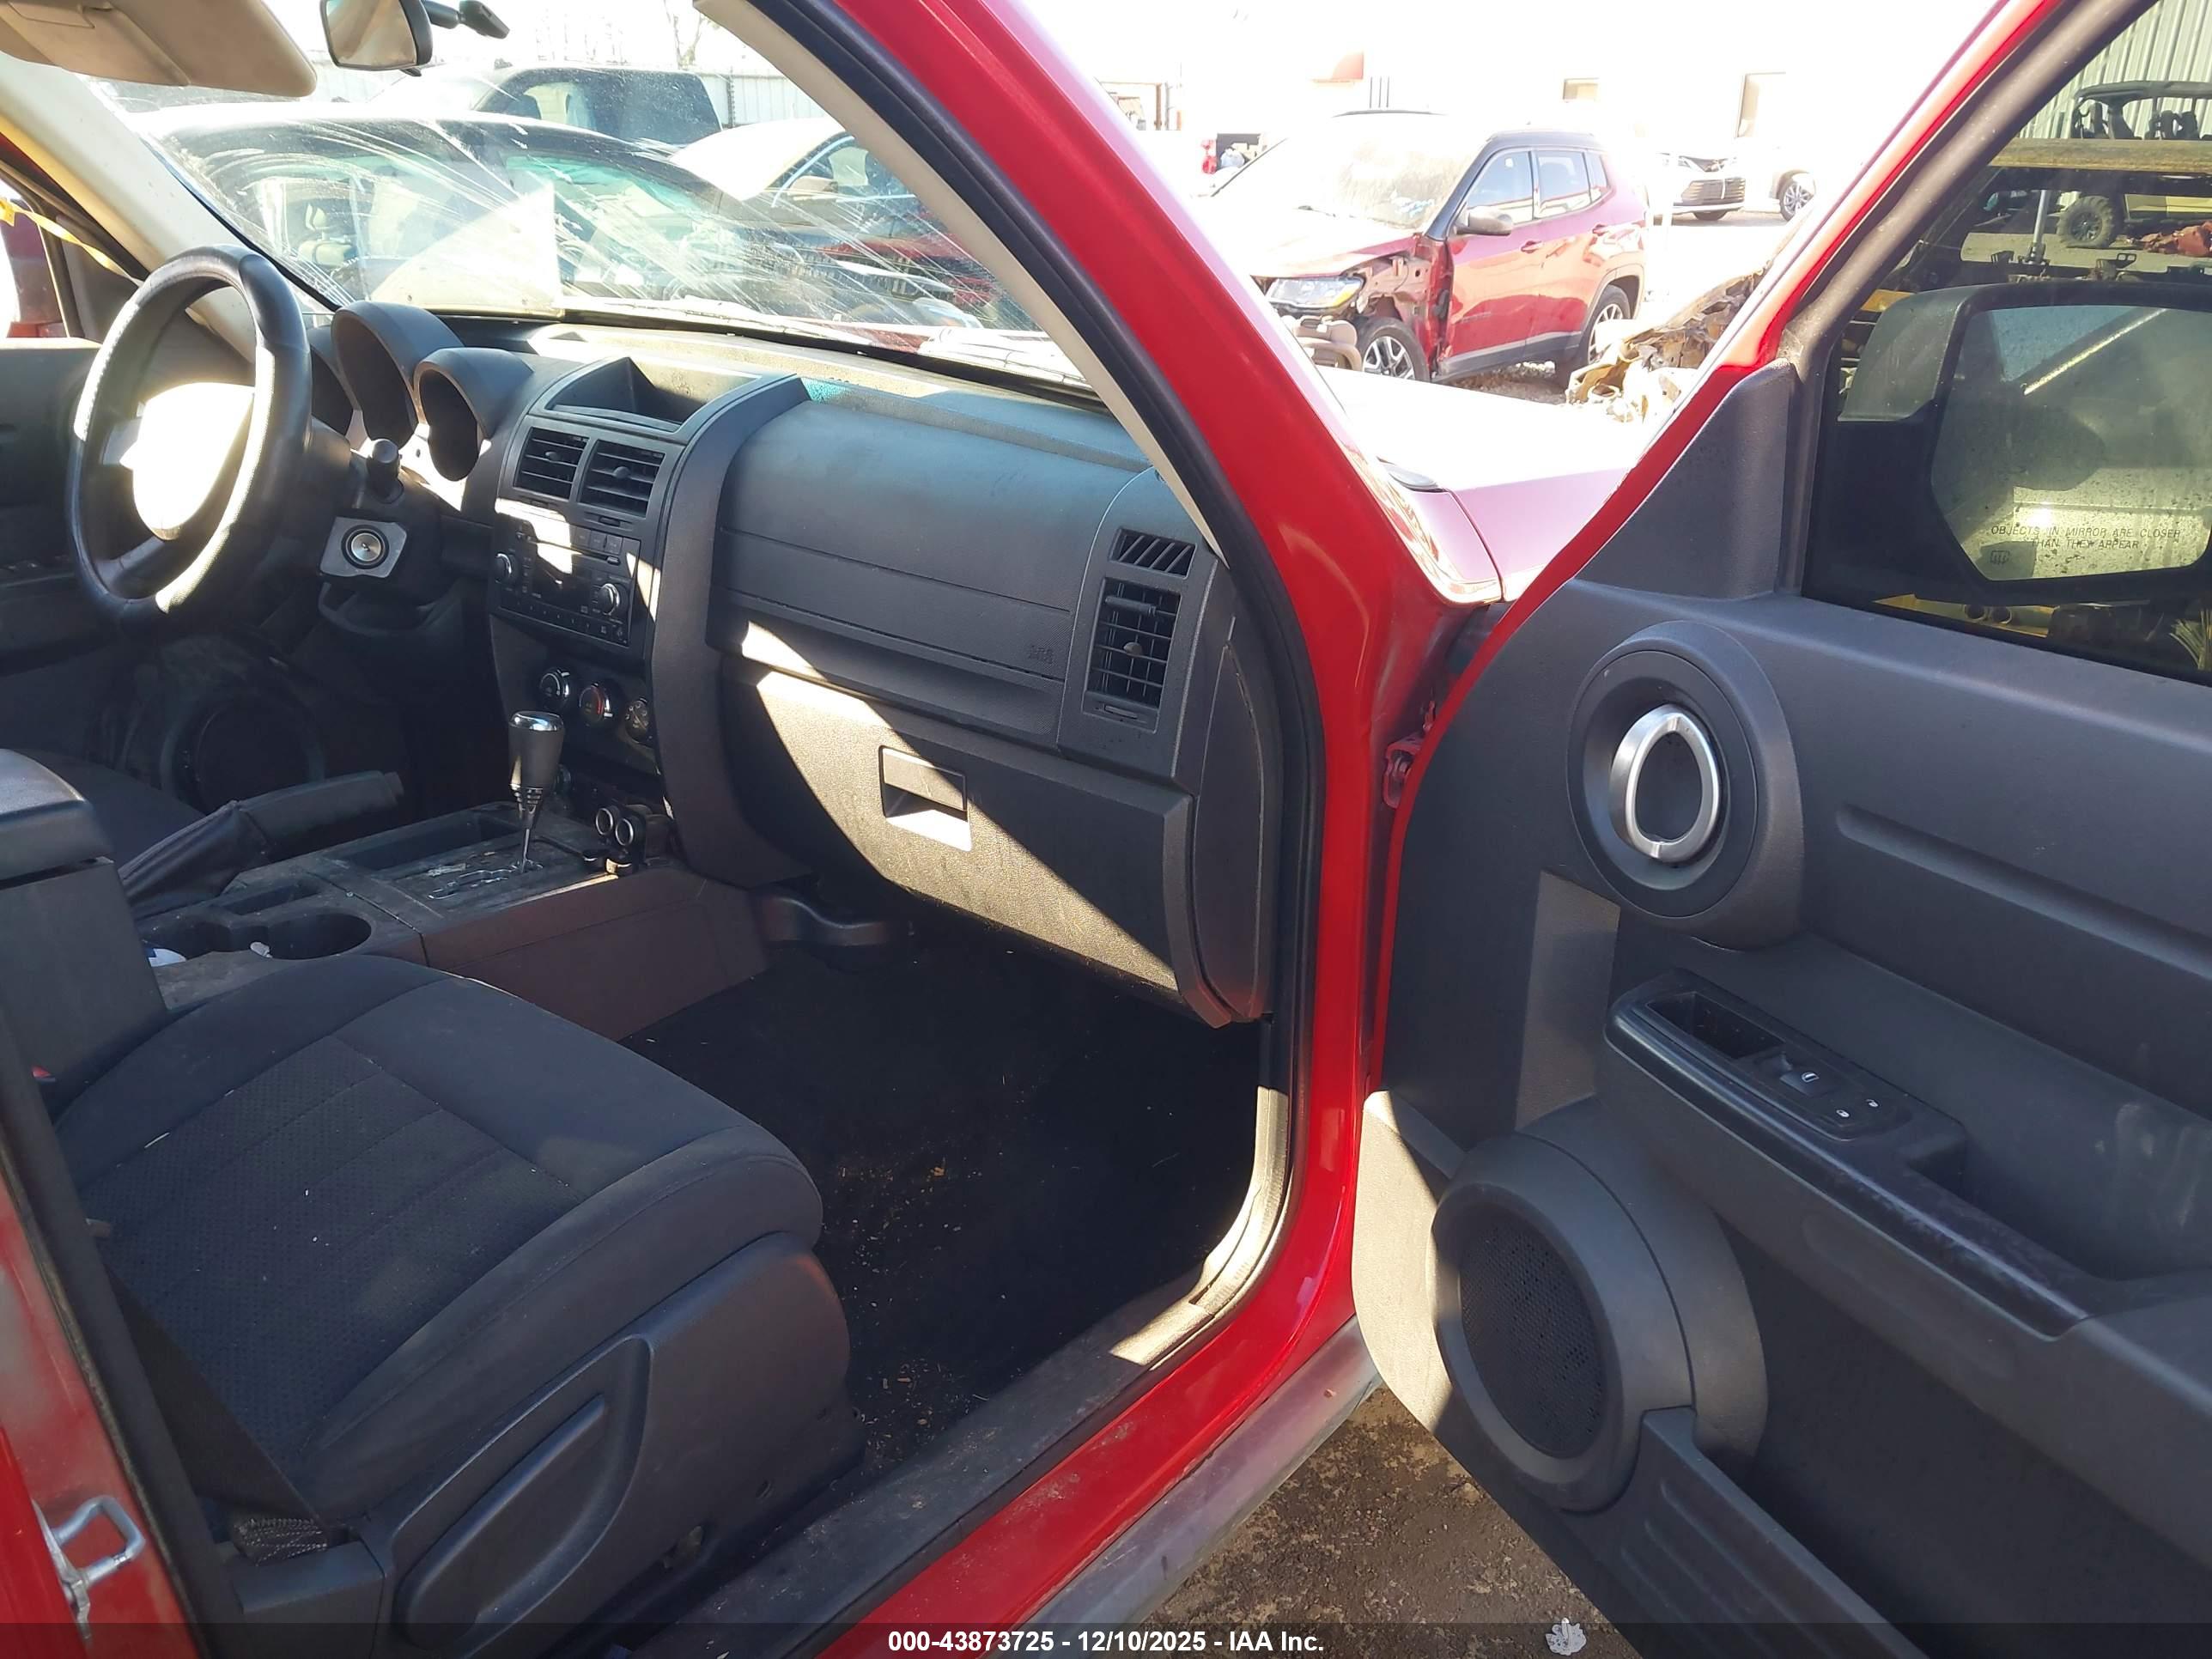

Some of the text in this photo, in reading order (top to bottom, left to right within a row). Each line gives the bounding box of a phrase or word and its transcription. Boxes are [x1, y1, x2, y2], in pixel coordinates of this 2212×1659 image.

[1990, 525, 2181, 538] OBJECTS IN MIRROR ARE CLOSER
[2032, 538, 2140, 550] THAN THEY APPEAR
